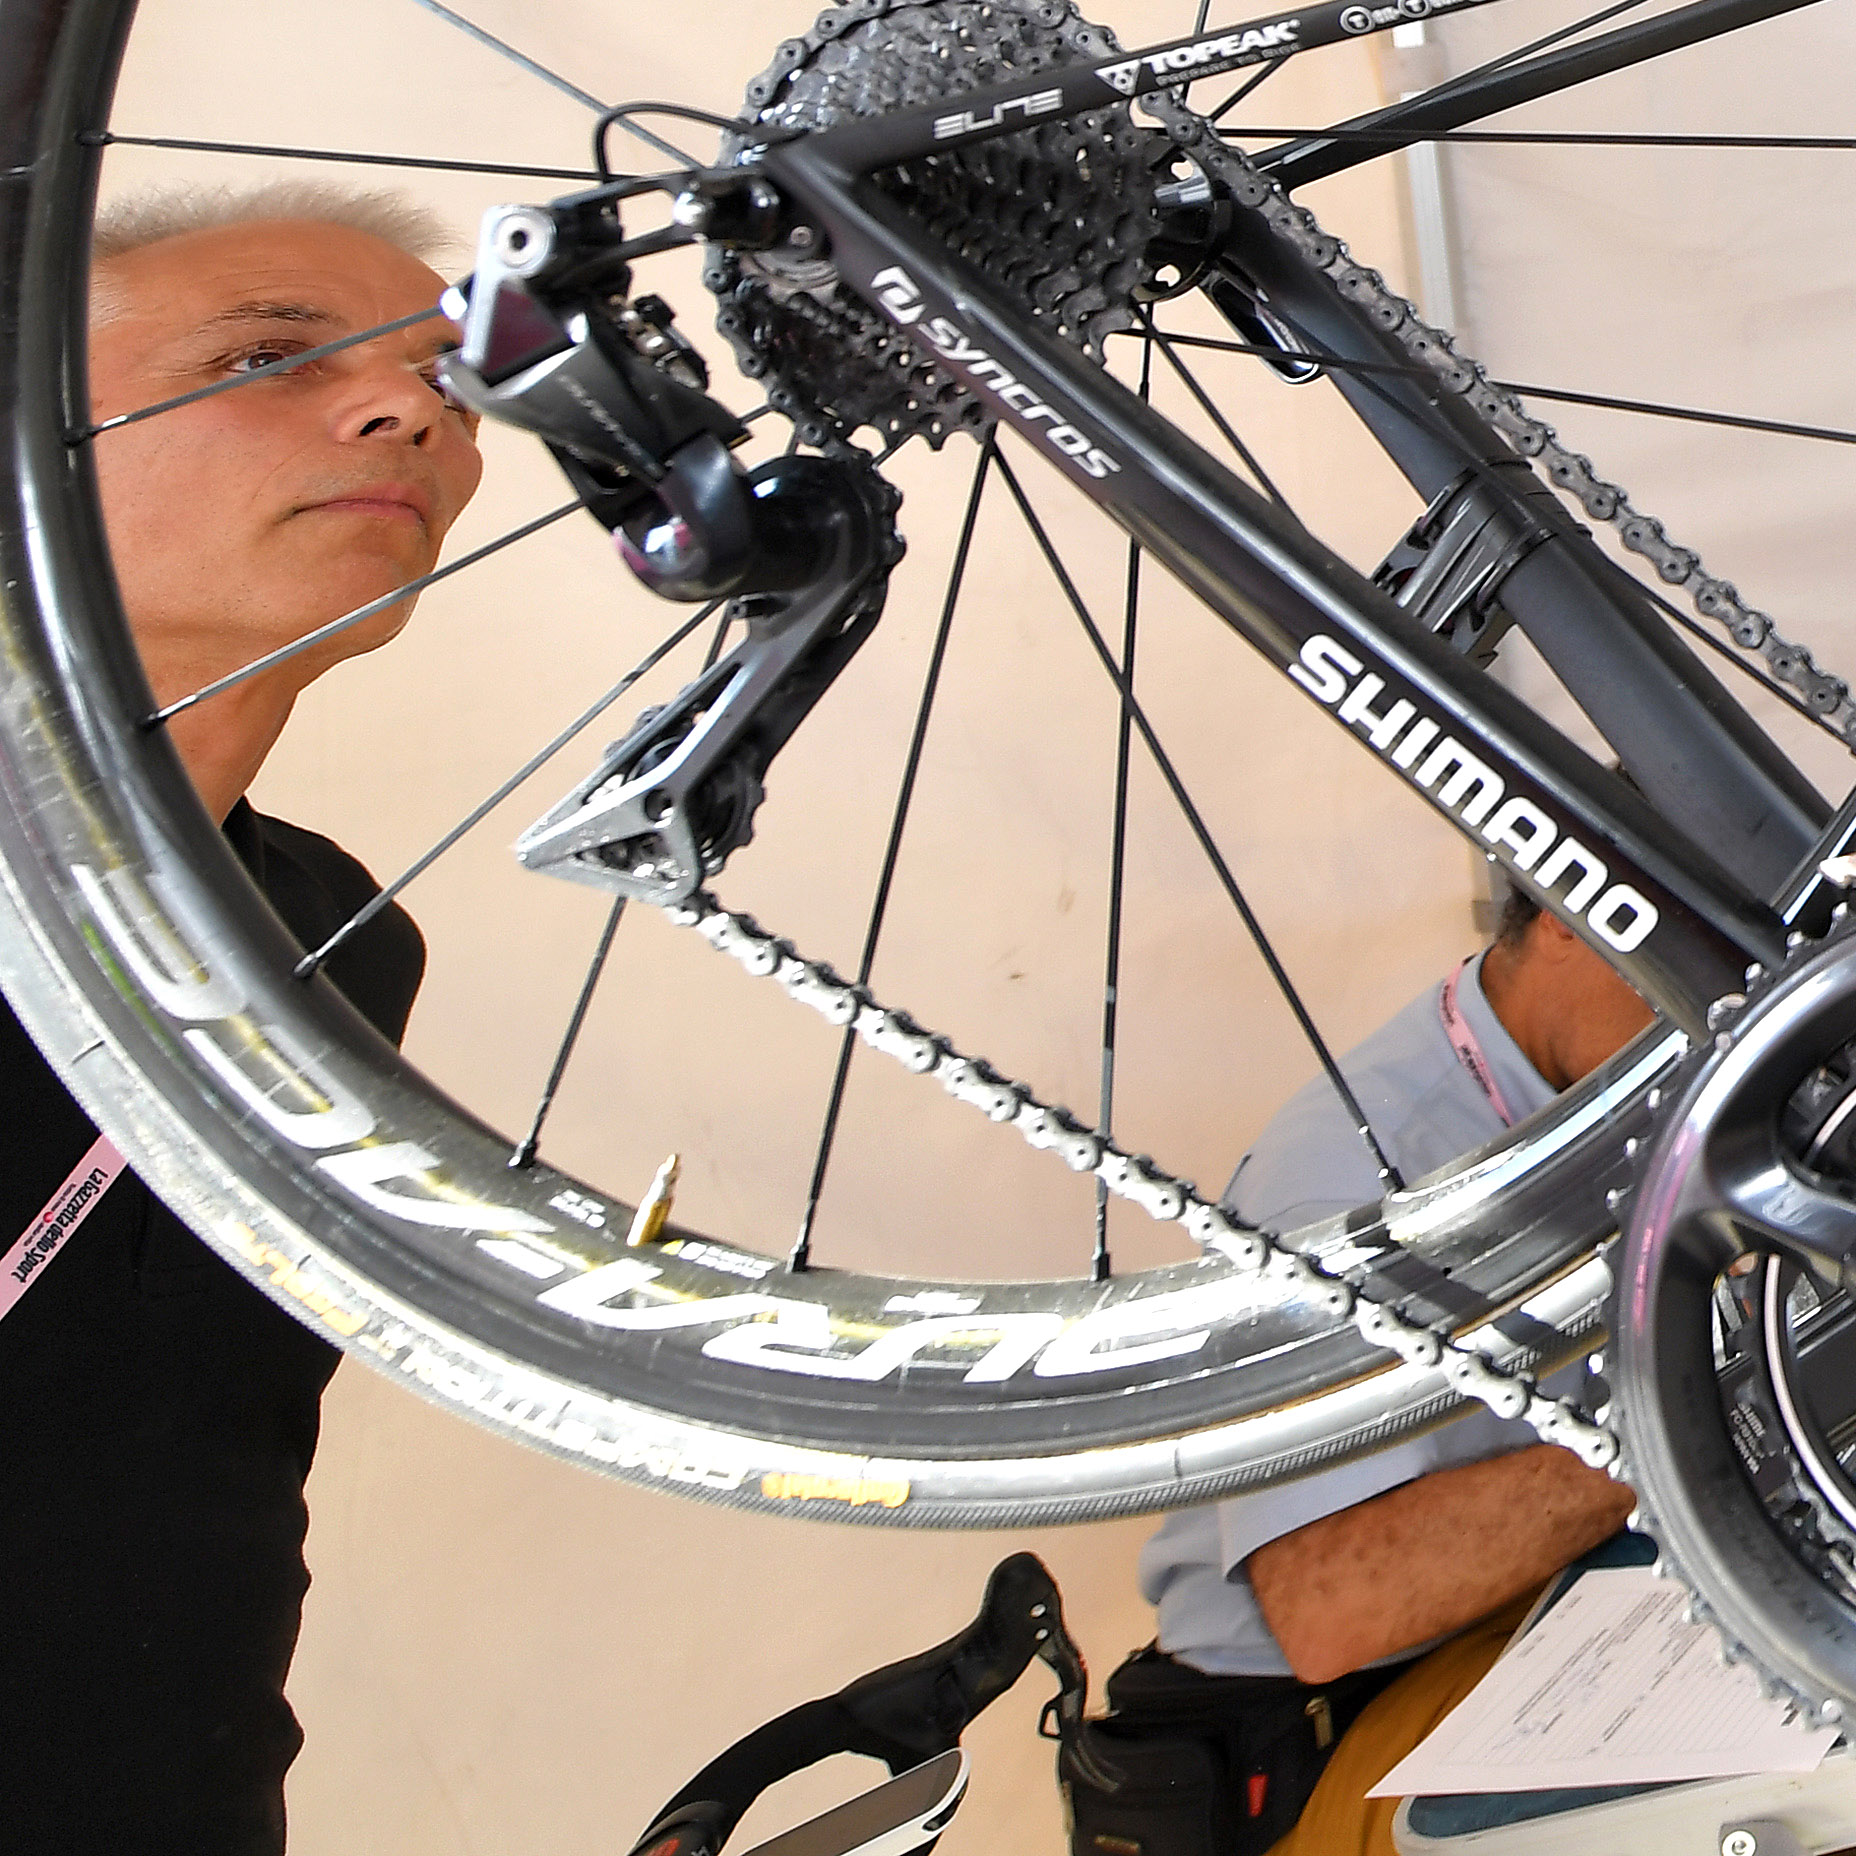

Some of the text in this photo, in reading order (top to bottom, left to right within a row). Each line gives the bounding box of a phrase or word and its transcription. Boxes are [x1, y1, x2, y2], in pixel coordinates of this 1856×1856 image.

[1287, 634, 1661, 953] SHIMANO
[11, 1167, 109, 1283] La Gazzetta dello Sport
